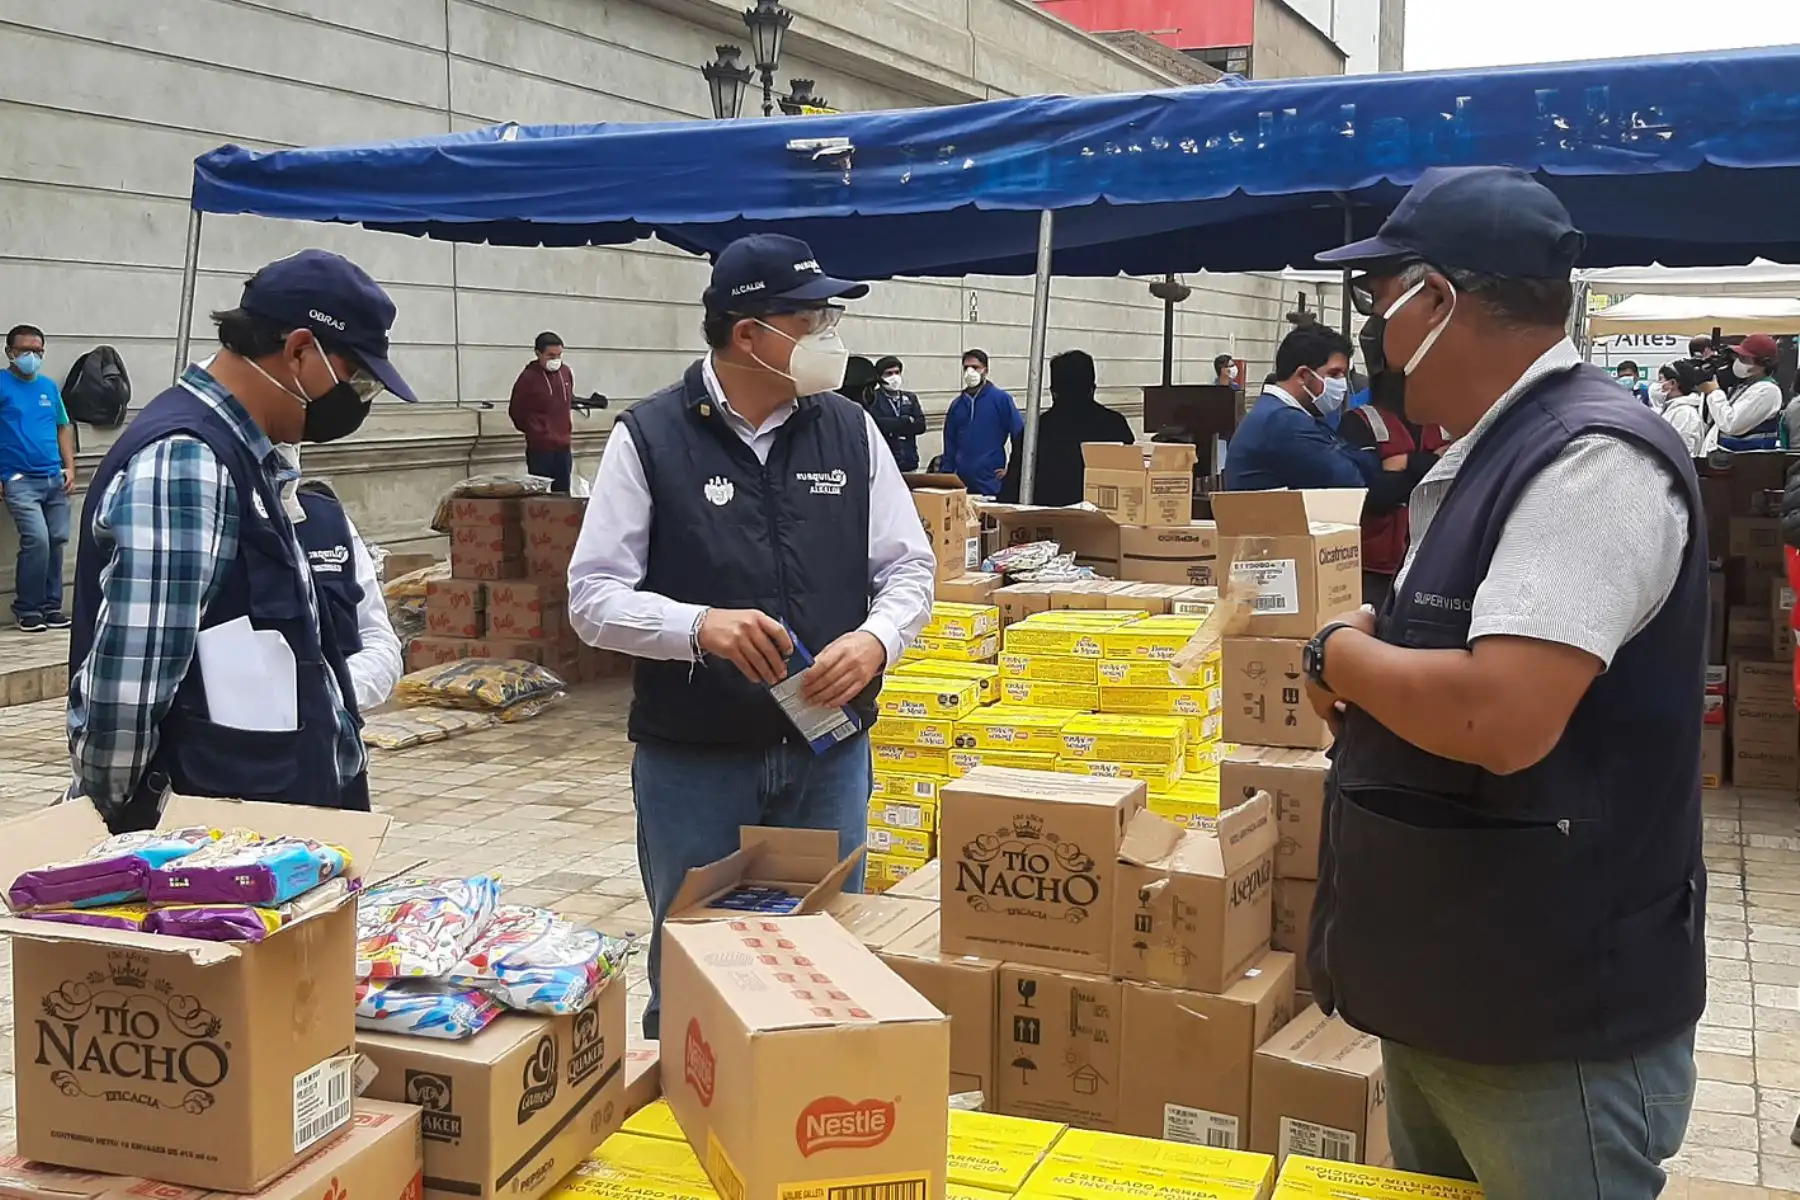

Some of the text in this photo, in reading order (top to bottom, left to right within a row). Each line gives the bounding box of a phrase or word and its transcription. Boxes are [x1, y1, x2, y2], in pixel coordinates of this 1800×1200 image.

[731, 281, 766, 297] ALCALDE
[308, 308, 346, 331] OBRAS
[1318, 545, 1359, 566] Cicatricure
[1413, 591, 1472, 611] SUPERVISO
[955, 860, 1099, 907] NACHO
[1229, 858, 1271, 912] Asepxia
[95, 1000, 160, 1040] TÍO
[34, 1019, 229, 1088] NACHO
[568, 1041, 604, 1081] QUAKER
[521, 1086, 554, 1111] Gamesa
[423, 1114, 461, 1133] AKER
[806, 1107, 887, 1139] Nestlé
[947, 1154, 1000, 1166] ARRIBA
[949, 1162, 1009, 1174] OSICION
[520, 1158, 555, 1192] PEPSICO
[1052, 1176, 1076, 1185] NO
[1069, 1171, 1218, 1199] ESTE LADO ARRIBA
[563, 1183, 586, 1192] NO
[583, 1179, 623, 1191] ESTE
[624, 1186, 665, 1198] LADO
